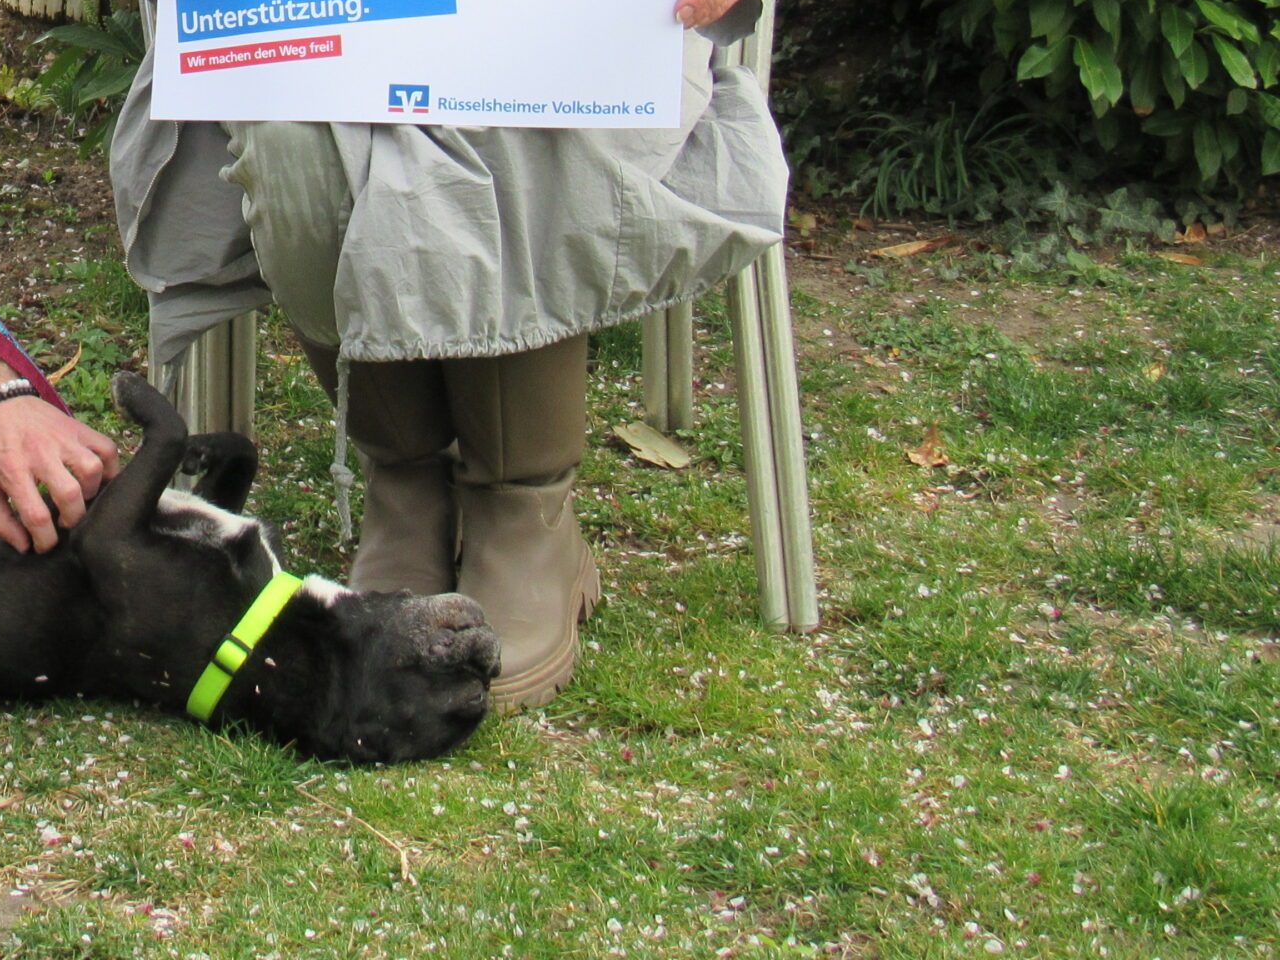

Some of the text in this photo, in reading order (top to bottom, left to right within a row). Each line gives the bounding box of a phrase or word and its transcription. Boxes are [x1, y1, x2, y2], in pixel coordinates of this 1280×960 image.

[187, 41, 333, 67] Wir machen den Weg frei!
[438, 98, 655, 114] Rüsselsheimer Volksbank eG
